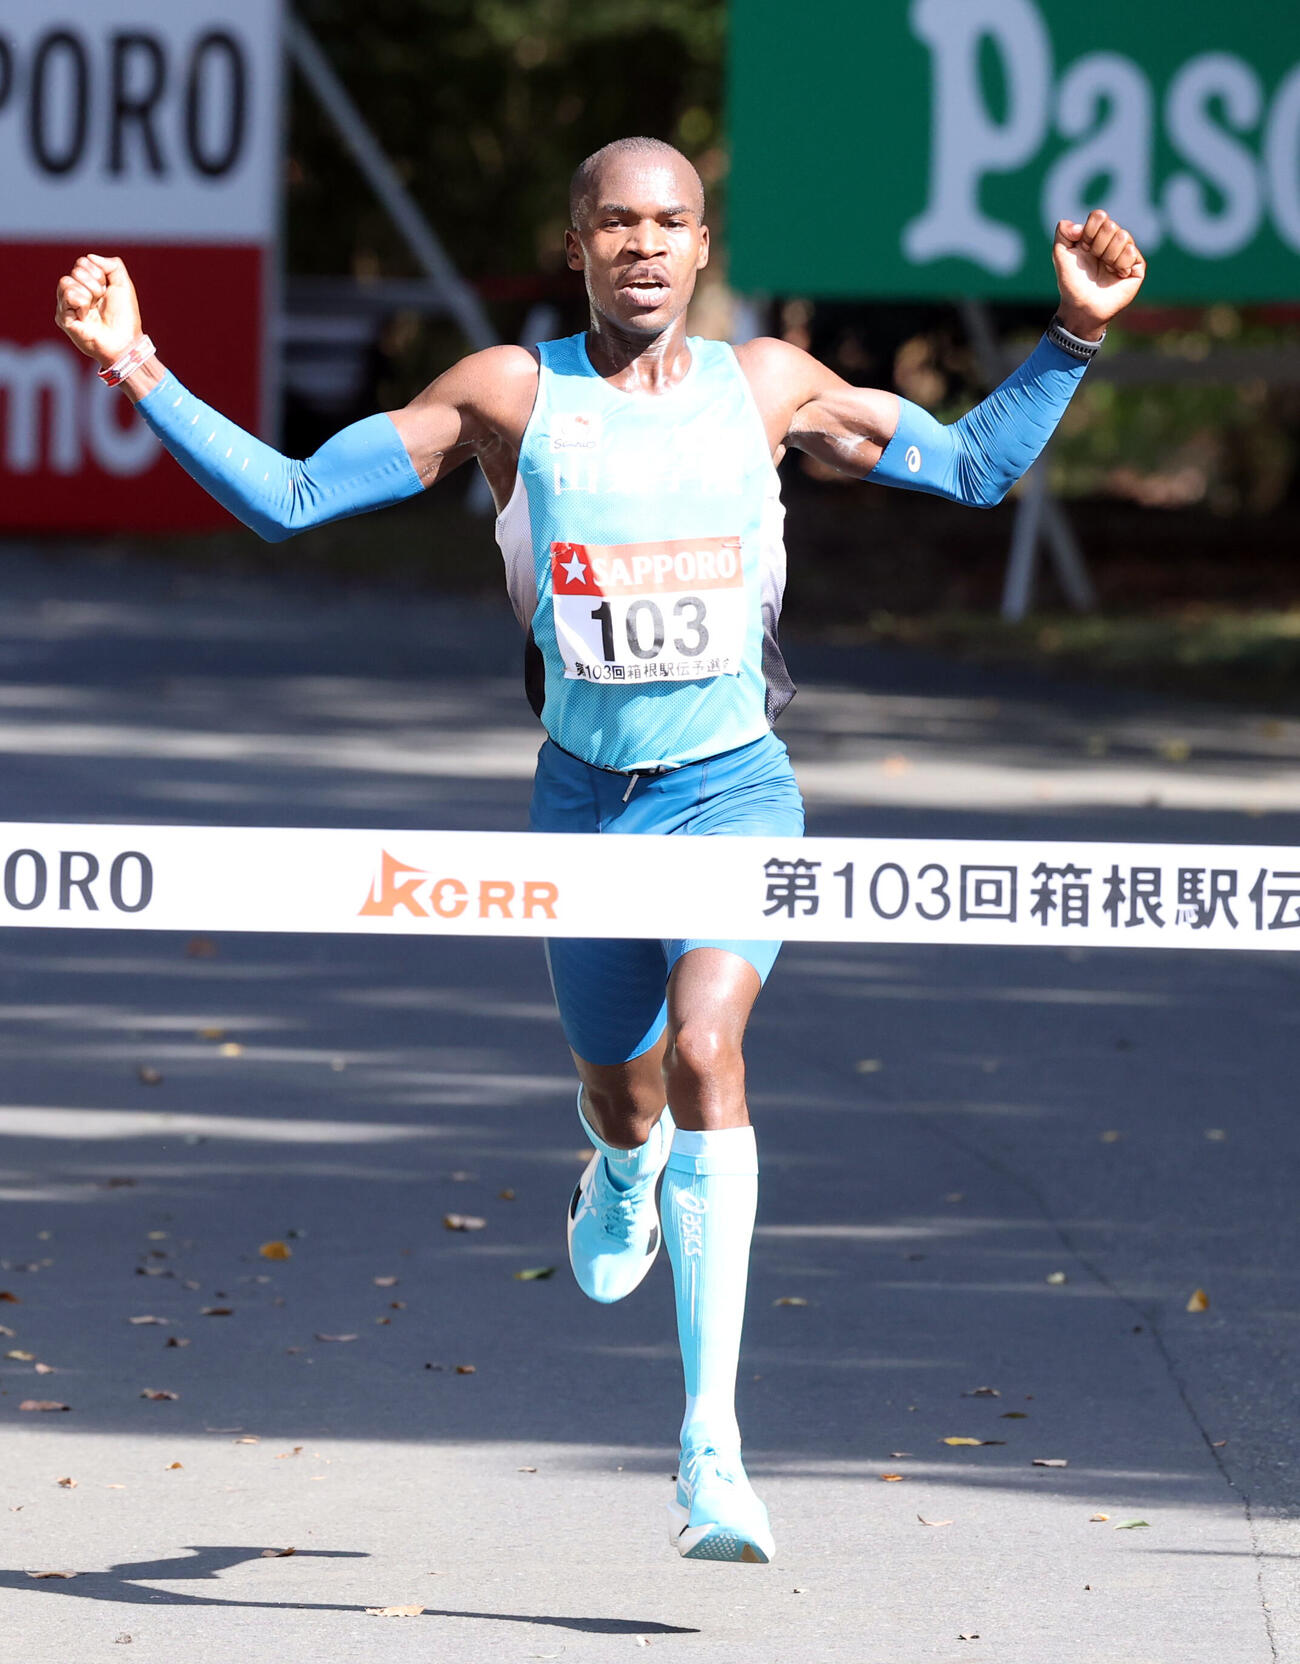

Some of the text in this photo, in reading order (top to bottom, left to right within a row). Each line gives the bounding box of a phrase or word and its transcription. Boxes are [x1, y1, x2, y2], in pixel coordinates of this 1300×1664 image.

[0, 29, 247, 178] ORO
[593, 549, 737, 587] SAPPORO
[591, 596, 709, 661] 103
[2, 848, 154, 913] ORO
[762, 857, 1300, 930] 第103回箱根駅伝
